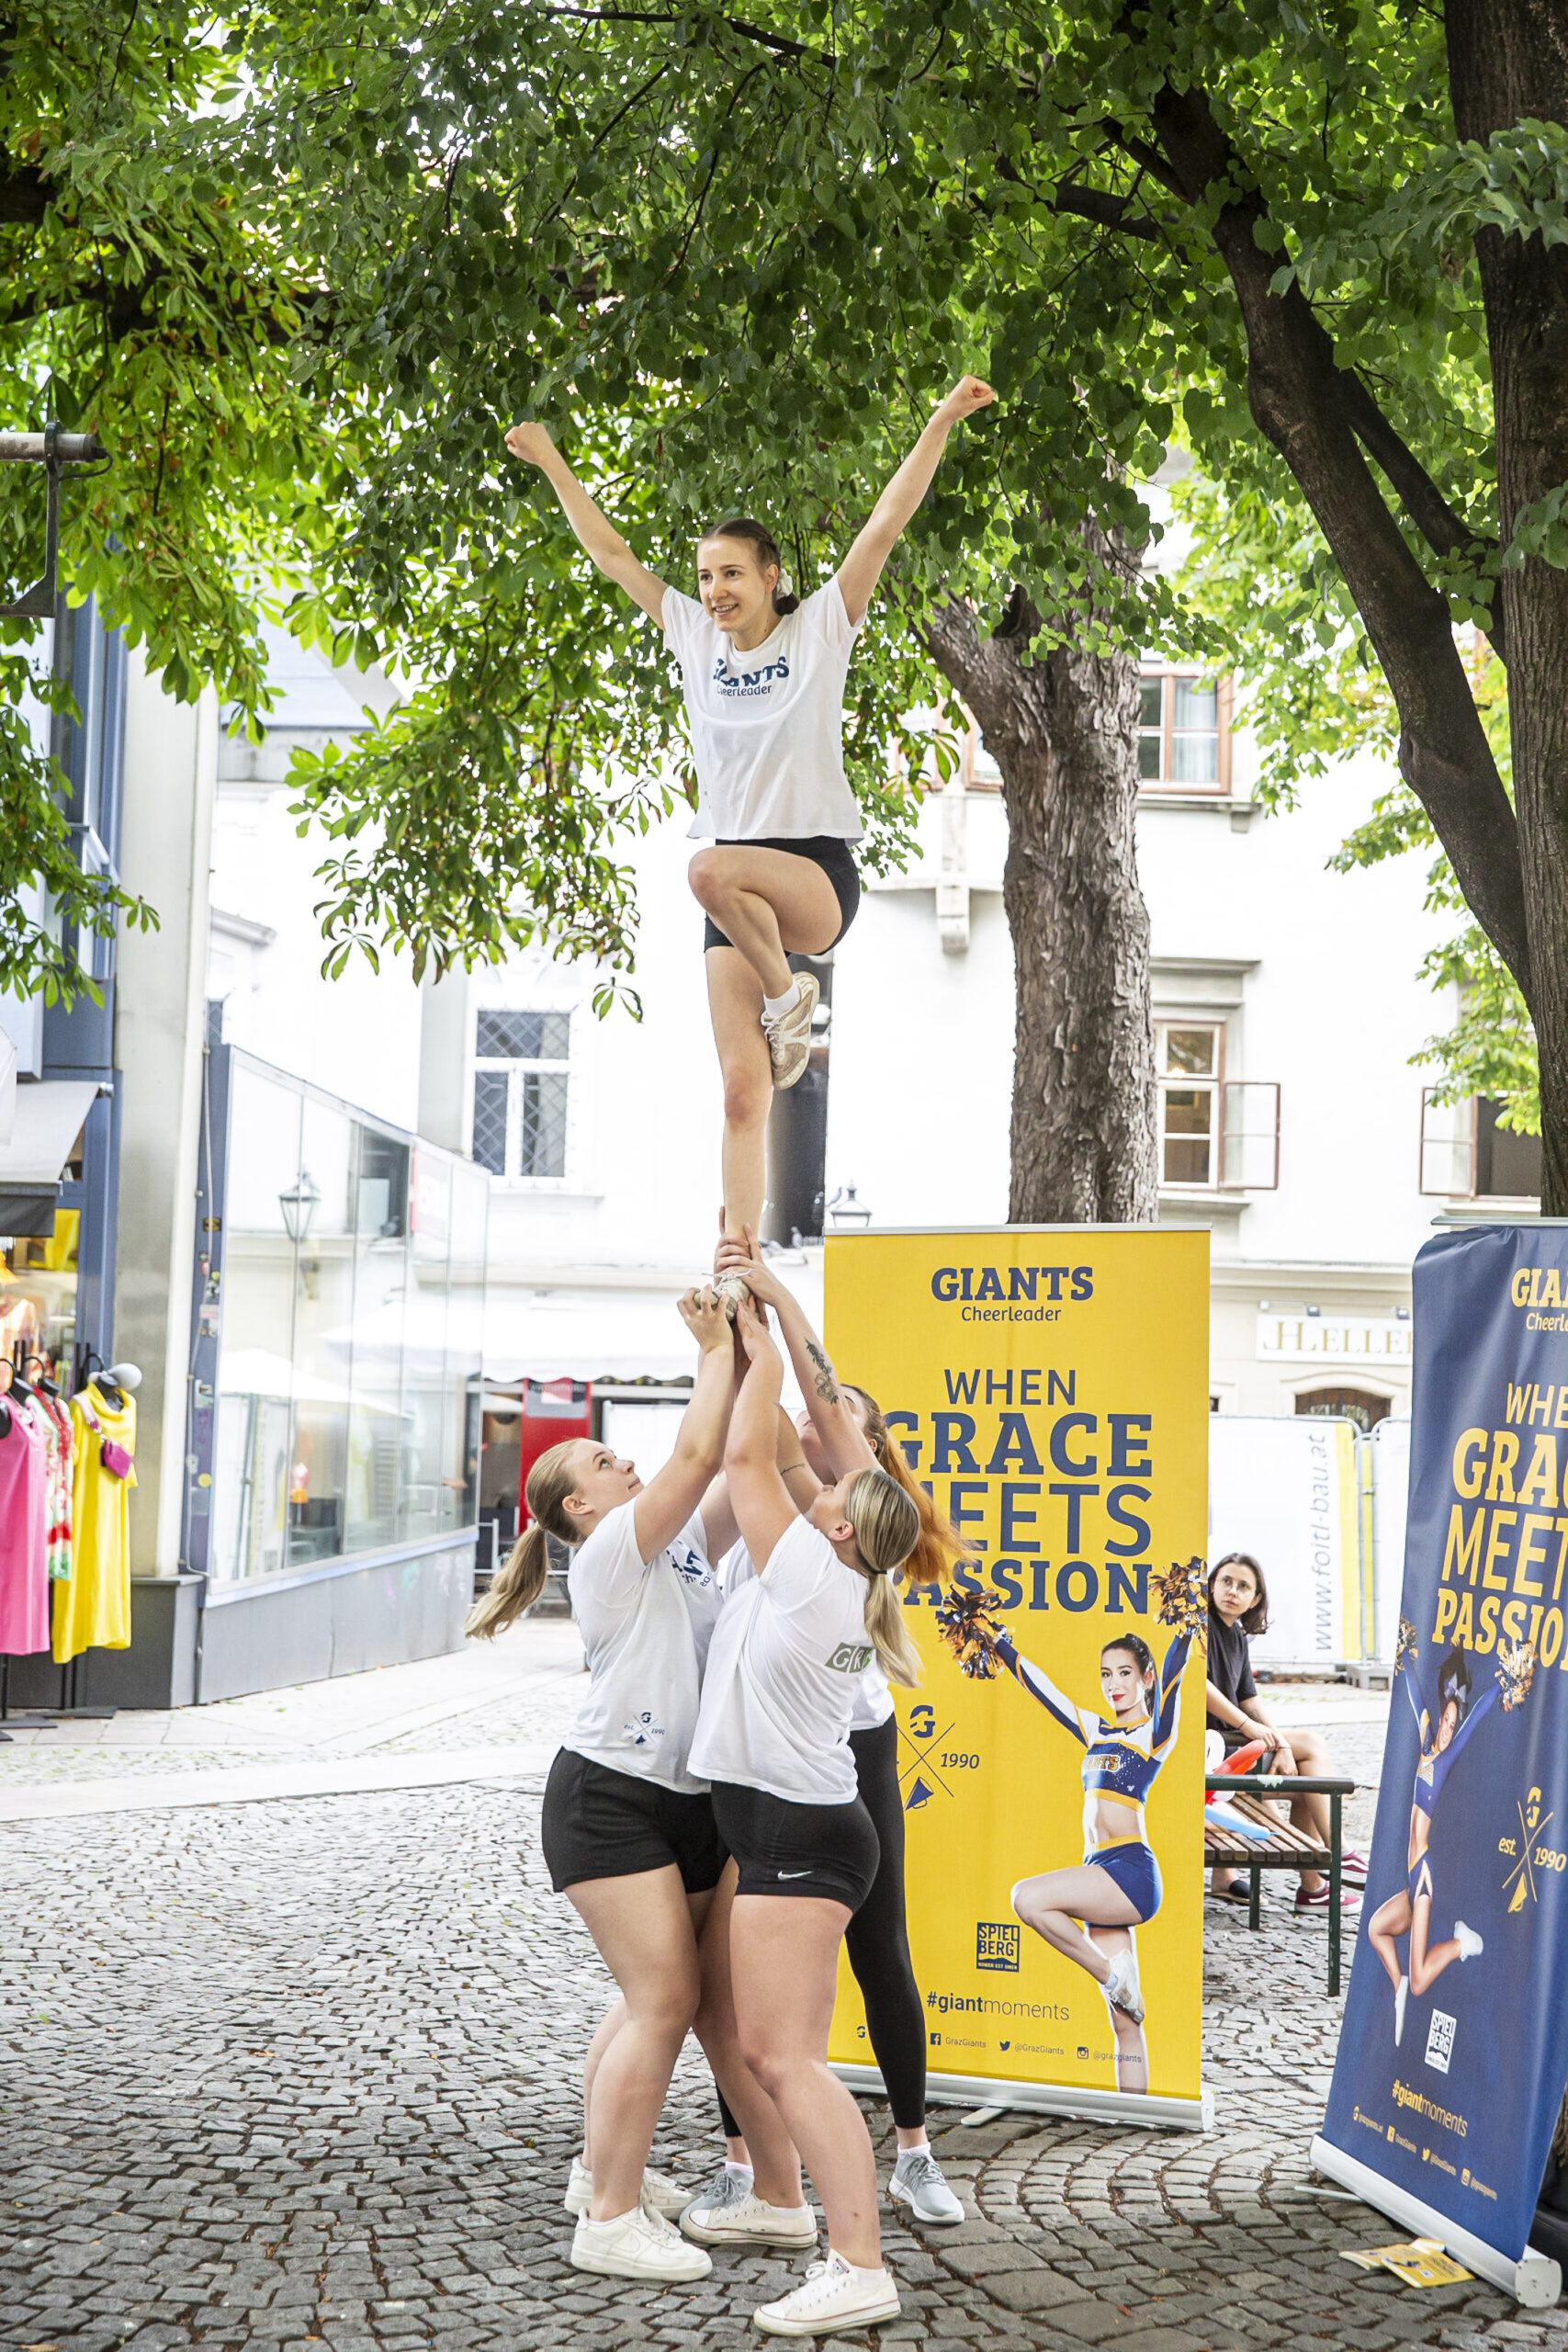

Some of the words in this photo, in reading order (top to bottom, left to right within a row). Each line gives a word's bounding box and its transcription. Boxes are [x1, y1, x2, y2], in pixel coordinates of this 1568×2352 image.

[931, 1266, 1094, 1302] GIANTS
[961, 1306, 1062, 1321] Cheerleader
[944, 1369, 1076, 1406] WHEN
[1452, 1428, 1568, 1508] GRA
[920, 1481, 1153, 1556] EETS
[1309, 1433, 1332, 1651] www.foitl-bau.at
[1432, 1588, 1568, 1671] PASSIO
[941, 1753, 980, 1769] 1990
[1534, 1847, 1567, 1871] 1990
[978, 1925, 1018, 1941] SPIEL
[978, 1940, 1014, 1957] BERG
[927, 1992, 1070, 2021] #giantmoments
[945, 2036, 987, 2048] GrazGiants
[1014, 2042, 1065, 2055] @GrazGiants
[1093, 2051, 1142, 2063] @grazgiants
[1393, 2079, 1468, 2137] #giantmoments
